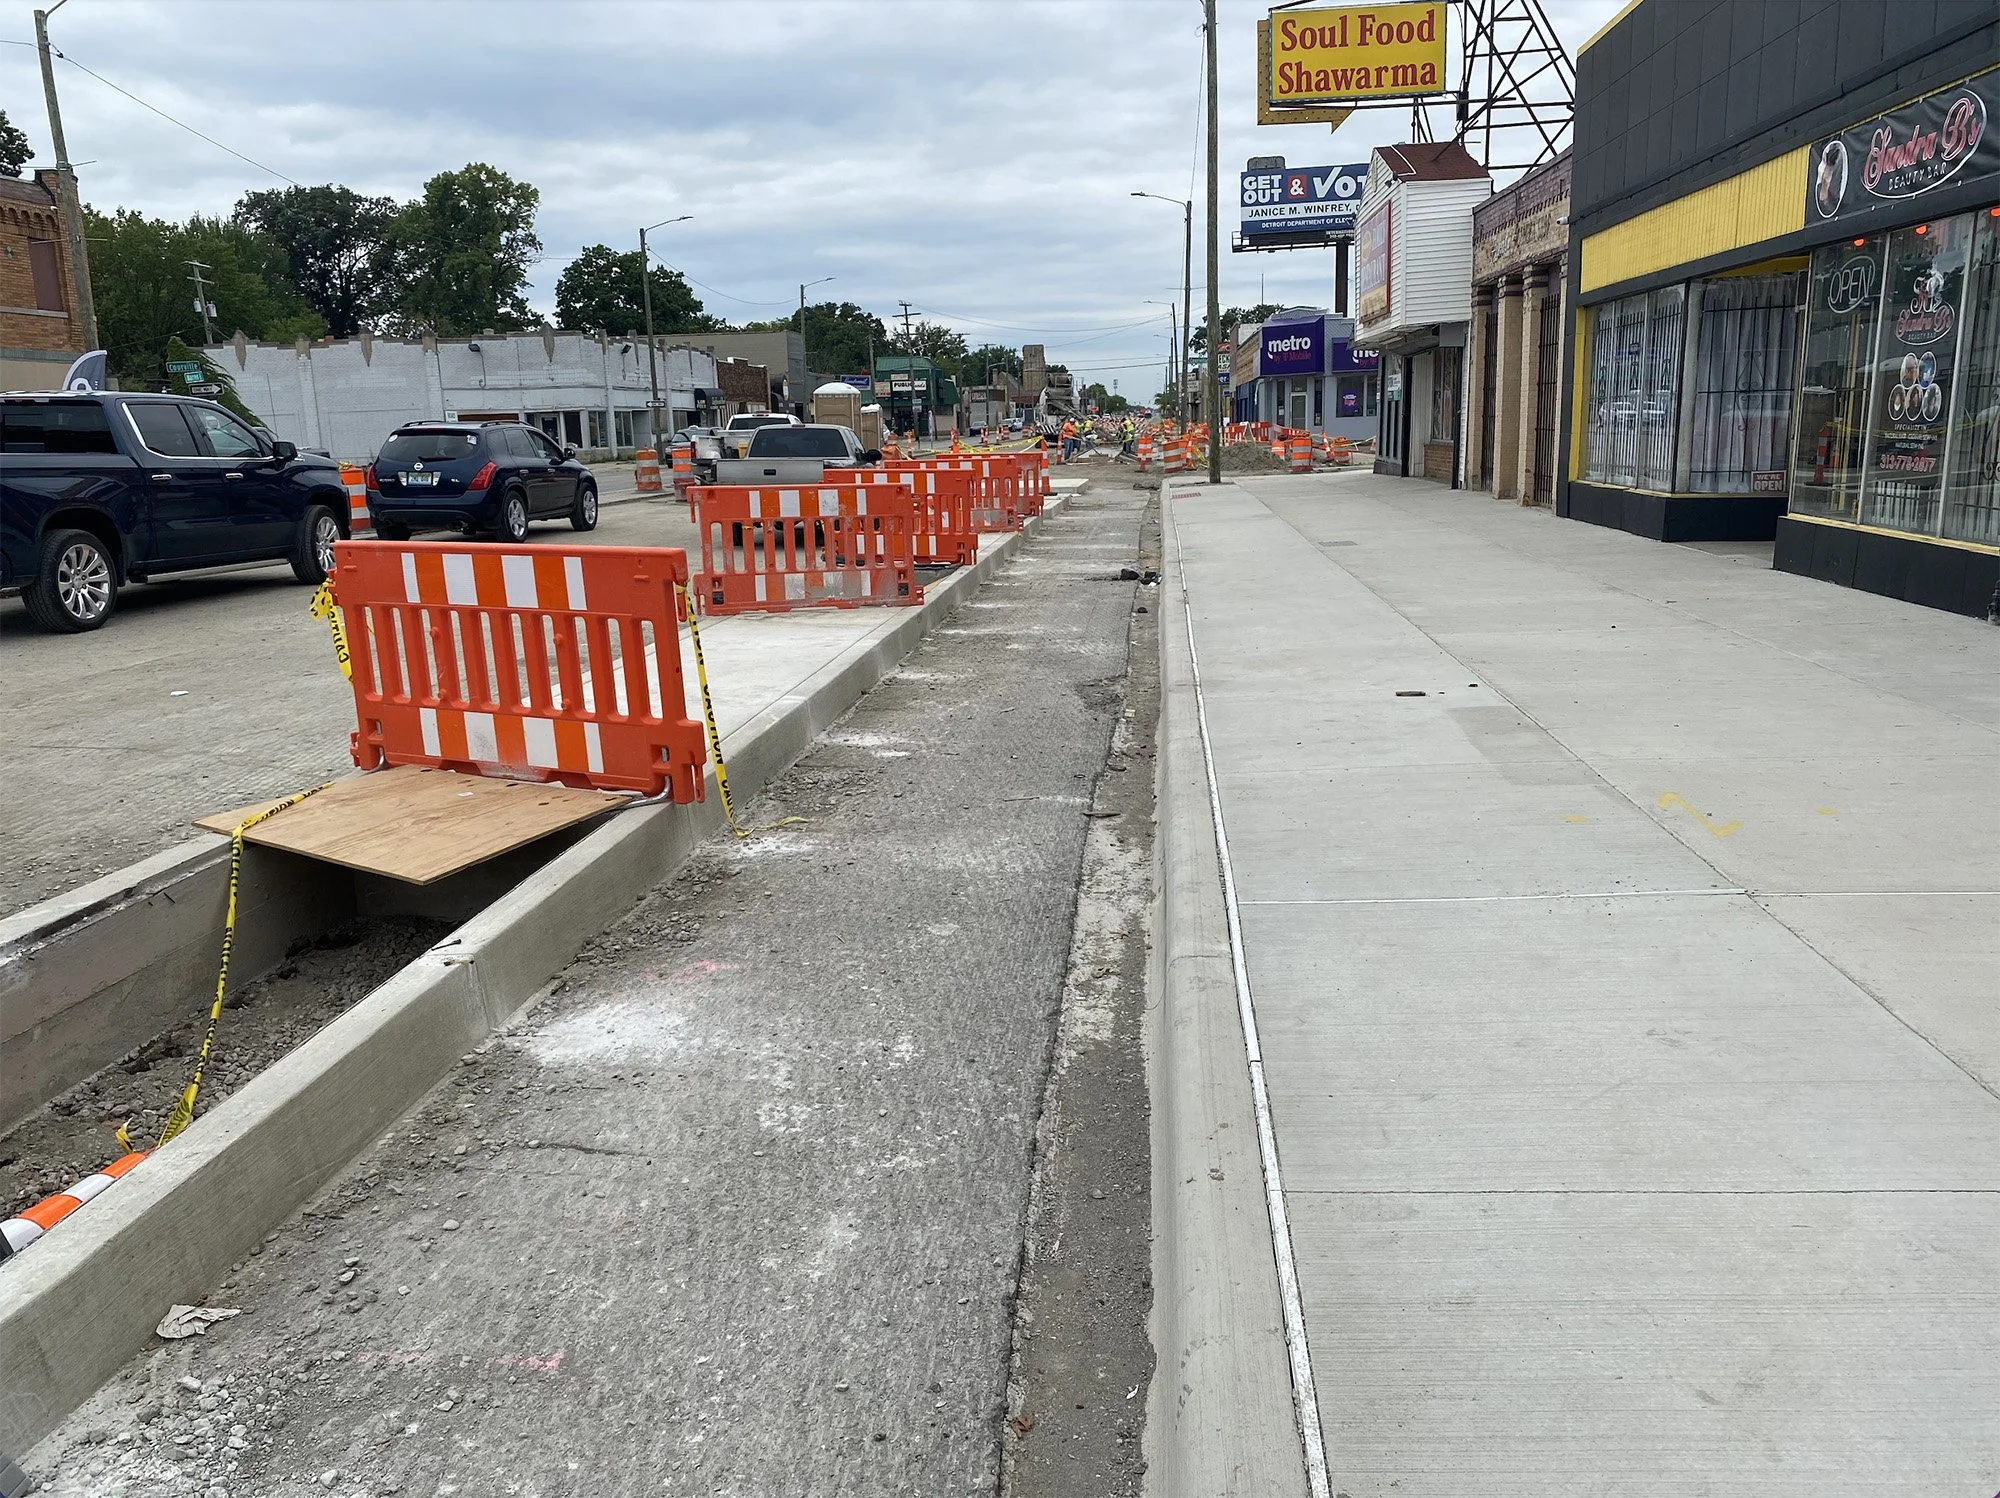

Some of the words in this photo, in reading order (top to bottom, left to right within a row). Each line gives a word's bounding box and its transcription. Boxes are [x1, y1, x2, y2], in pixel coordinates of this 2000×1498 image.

[1281, 15, 1348, 51] Soul
[1357, 9, 1435, 46] Food
[1278, 61, 1437, 94] Shawarma
[1863, 124, 1938, 189] Sandra
[1243, 175, 1282, 190] GET
[1887, 168, 1926, 191] BEAUTY
[1927, 161, 1947, 179] BAR
[1290, 178, 1305, 196] &
[1243, 188, 1282, 204] OUT
[1248, 207, 1286, 218] JANICE
[1288, 207, 1301, 215] M.
[1303, 203, 1353, 215] WINFREY,
[1261, 221, 1286, 229] DETROIT
[1286, 218, 1325, 228] DEPARTMENT
[1829, 265, 1873, 304] OPEN
[1268, 335, 1311, 352] metro
[1754, 480, 1783, 491] OPEN
